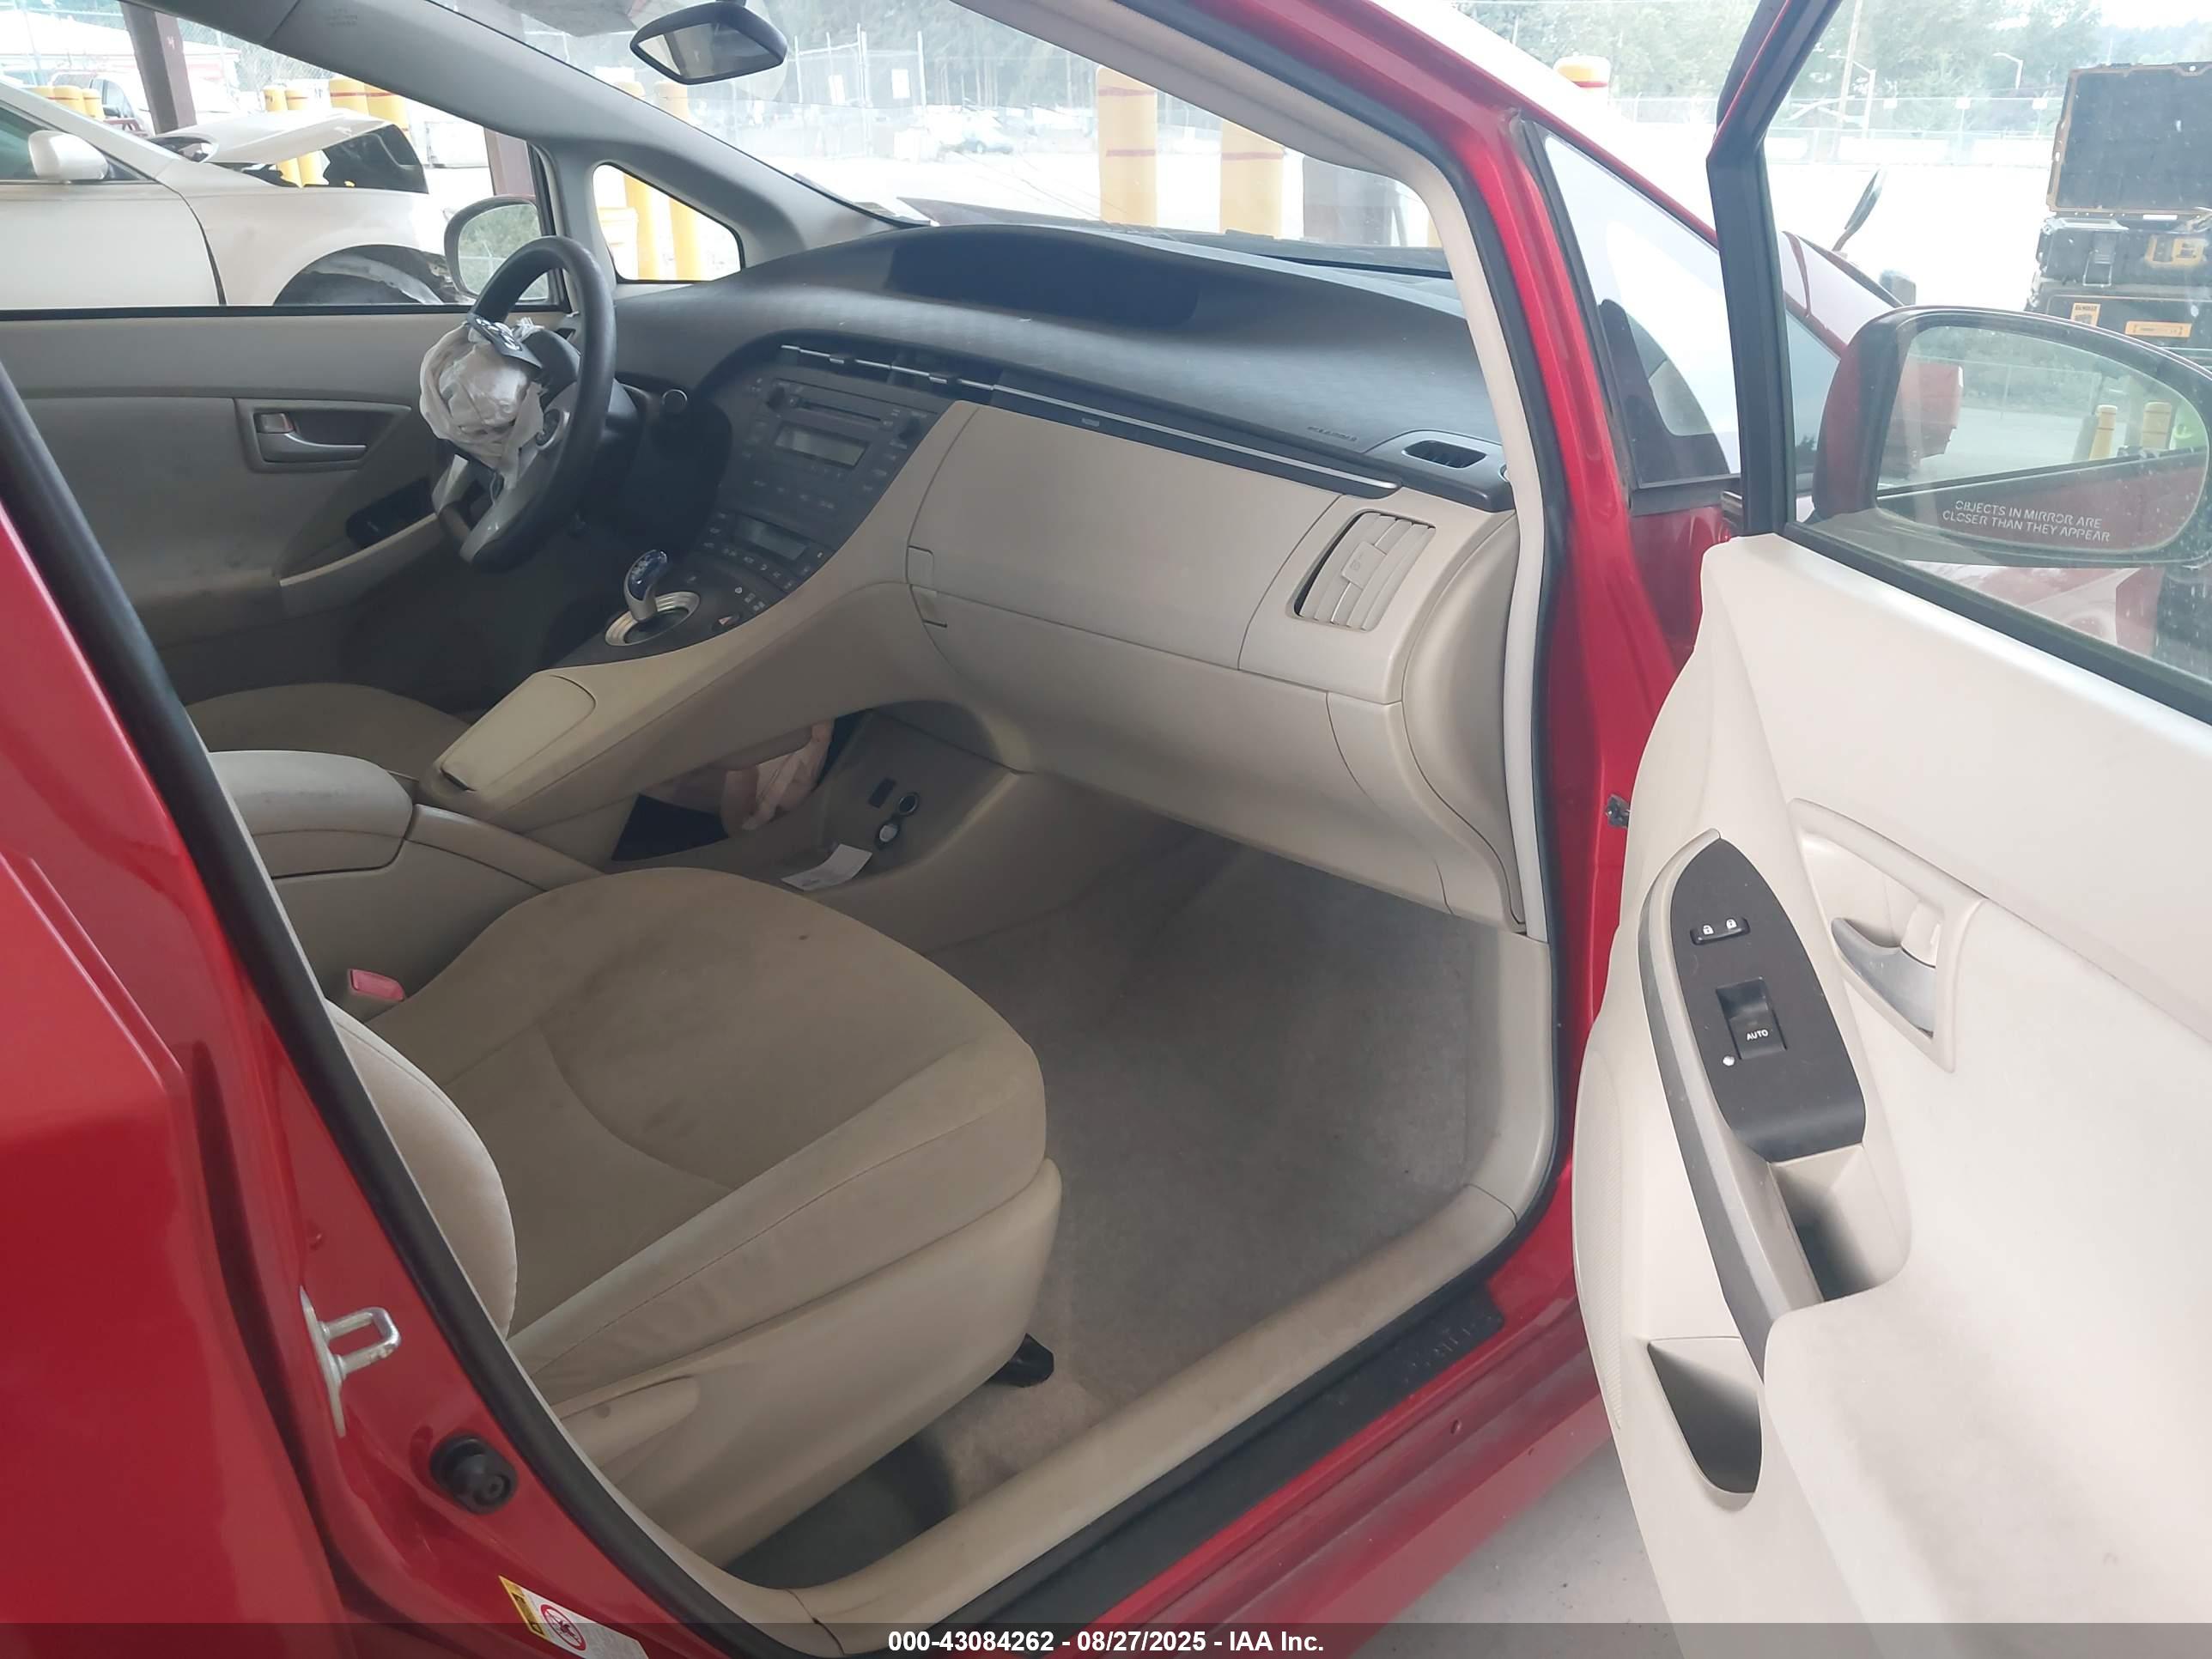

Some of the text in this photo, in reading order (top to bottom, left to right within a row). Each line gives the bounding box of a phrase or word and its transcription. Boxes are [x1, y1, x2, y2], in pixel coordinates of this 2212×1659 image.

[1942, 510, 2111, 543] CLOSER THAN THEY APPEAR
[1955, 500, 2103, 529] OBJECTS IN MIRROR ARE
[1746, 1029, 1770, 1042] AUTO
